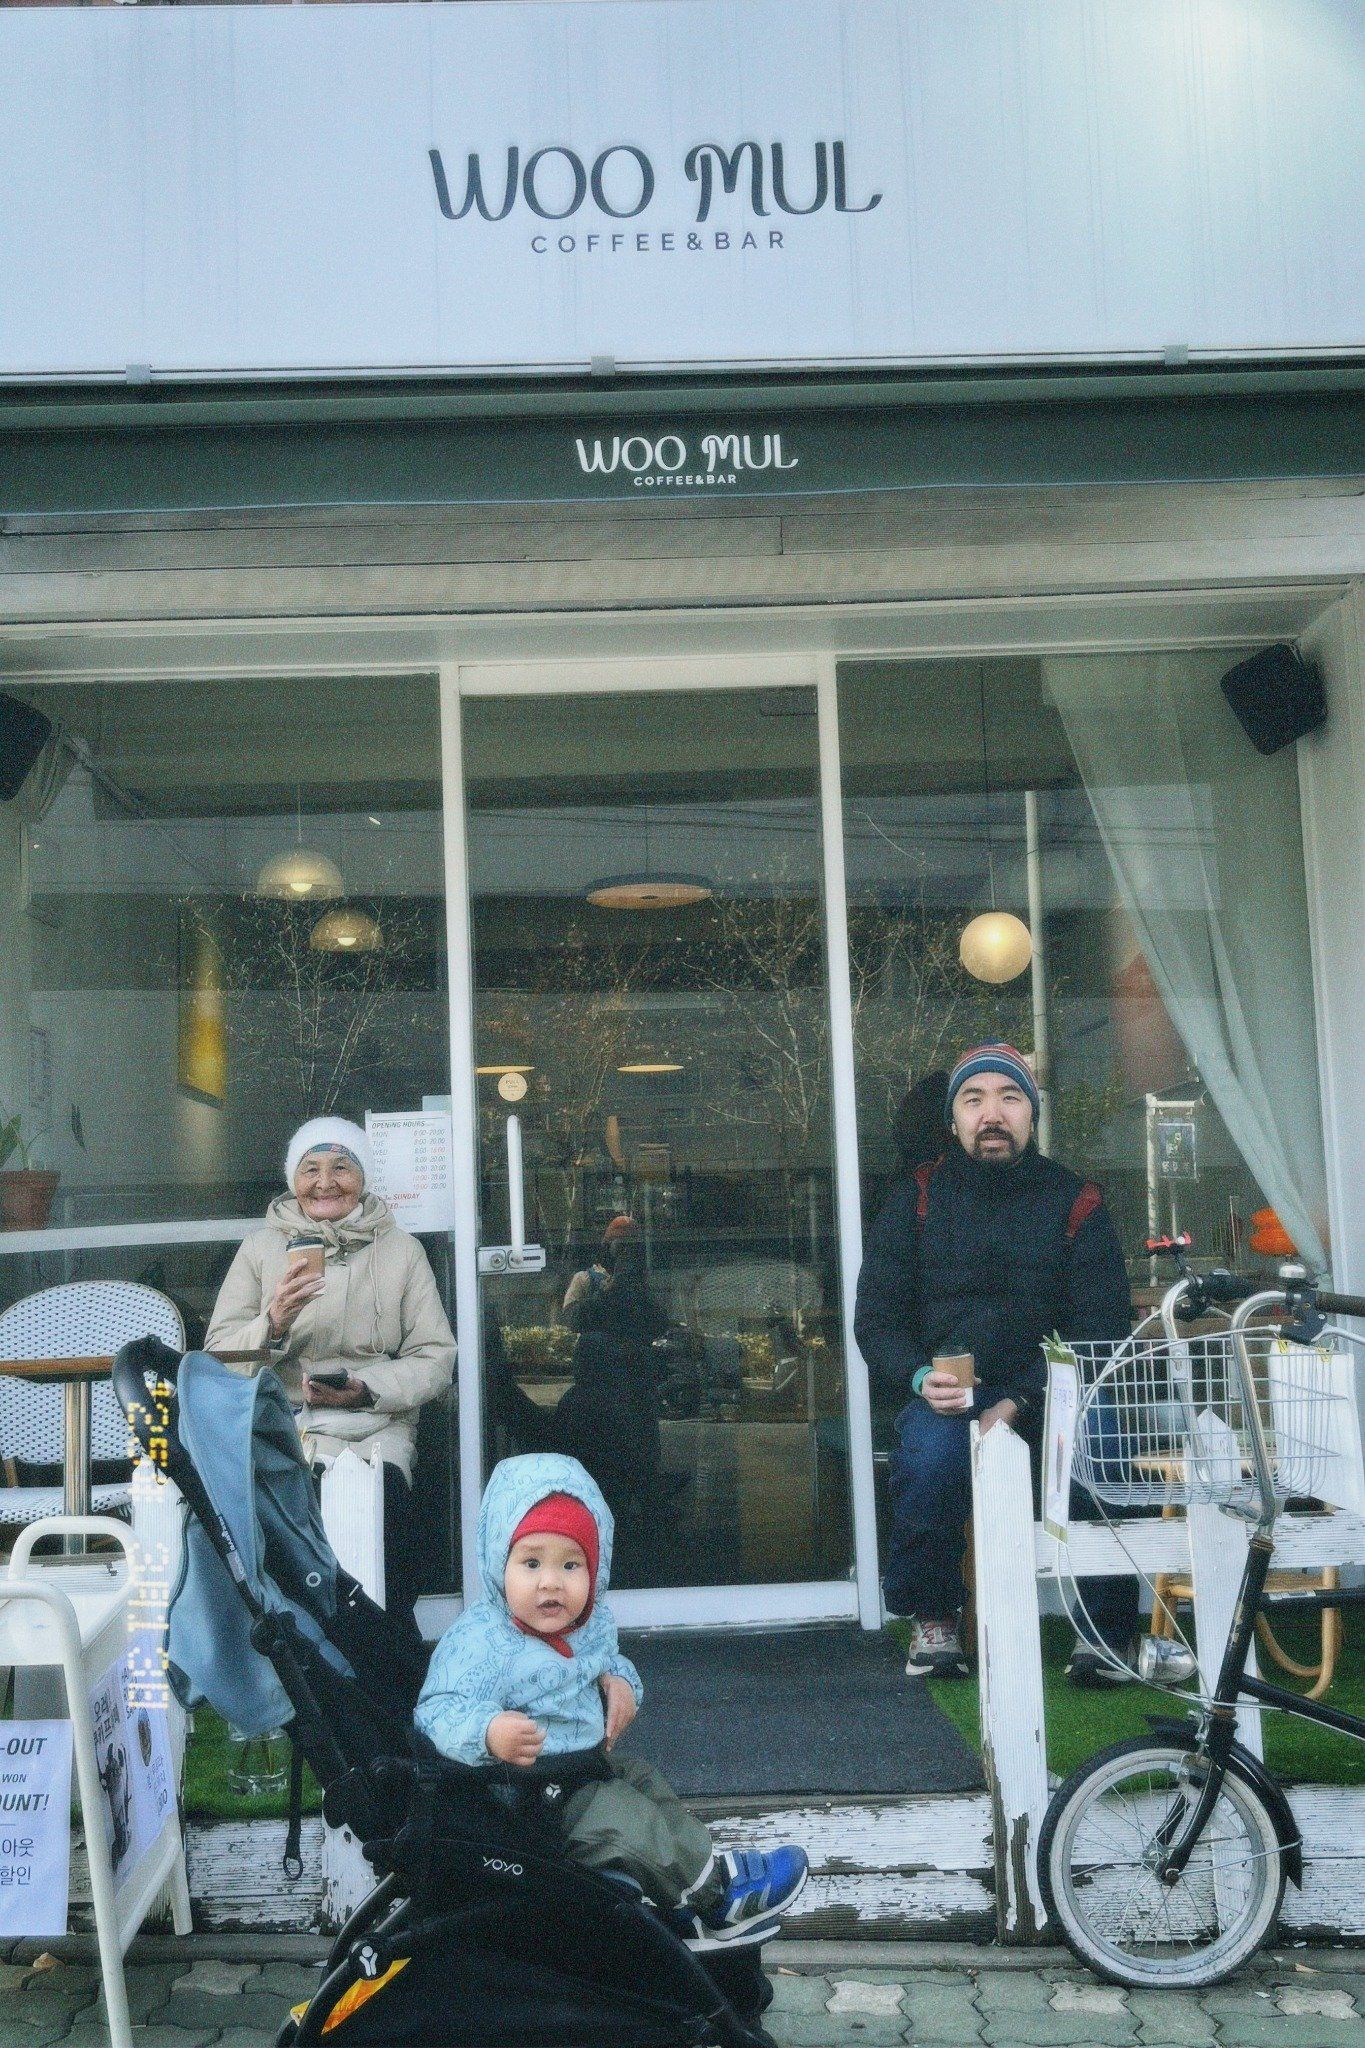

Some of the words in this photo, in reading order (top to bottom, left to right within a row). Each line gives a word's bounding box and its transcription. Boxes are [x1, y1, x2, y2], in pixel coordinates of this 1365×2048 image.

[428, 144, 655, 221] WOO
[683, 140, 883, 222] MUL
[531, 231, 785, 254] COFFEE&BAR
[575, 435, 687, 473] WOO
[701, 434, 799, 472] MUL
[633, 473, 738, 486] COFFEE&BAR
[371, 1121, 402, 1129] OPENING
[402, 1120, 426, 1128] HOURS
[393, 1193, 420, 1201] SUNDAY
[1, 1773, 27, 1783] WON
[0, 1793, 49, 1811] UNT!
[482, 1856, 523, 1875] YOYO
